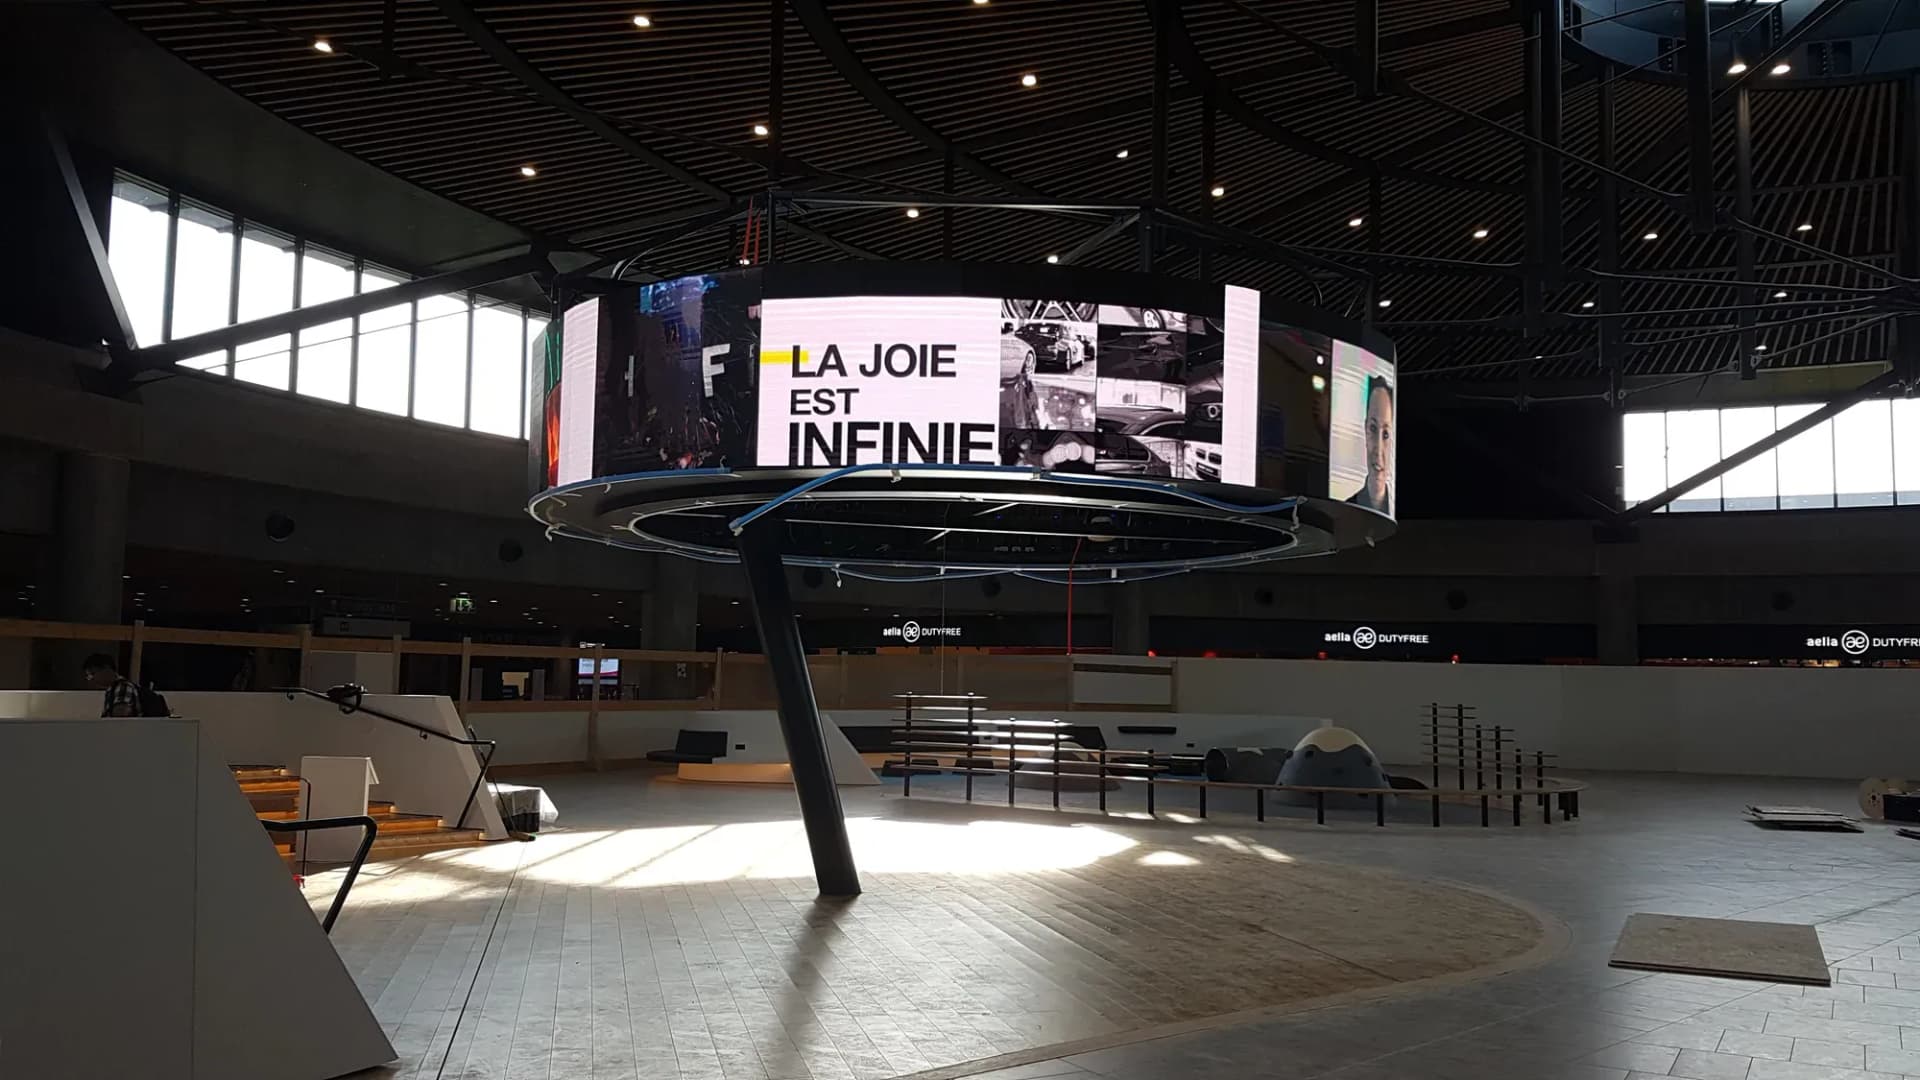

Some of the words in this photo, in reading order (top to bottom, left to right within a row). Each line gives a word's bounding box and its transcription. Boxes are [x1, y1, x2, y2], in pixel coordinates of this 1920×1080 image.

[791, 344, 848, 378] LA
[859, 343, 957, 378] JOIE
[790, 388, 859, 415] EST
[789, 421, 996, 467] INFINIE
[1379, 633, 1429, 644] DUTYFREE
[1807, 636, 1839, 647] aelia
[1872, 637, 1920, 647] DUTYFR
